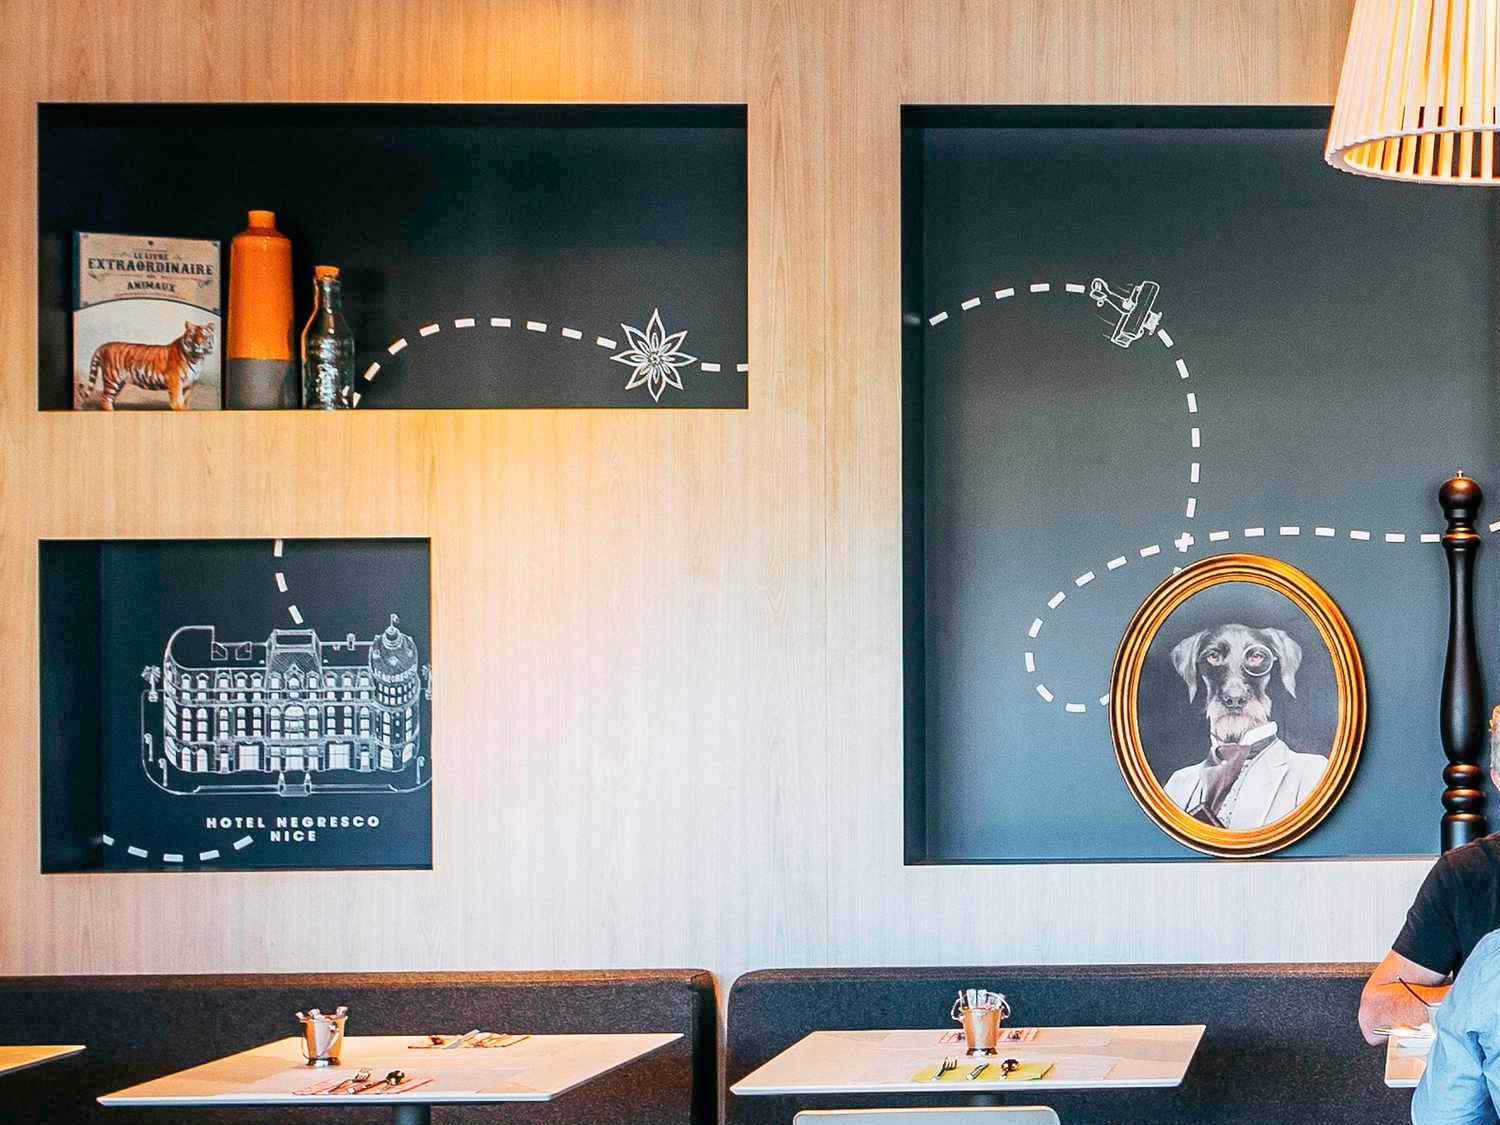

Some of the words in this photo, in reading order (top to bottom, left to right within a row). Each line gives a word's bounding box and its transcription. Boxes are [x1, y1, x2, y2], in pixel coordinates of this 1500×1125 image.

[88, 258, 214, 275] EXTRAORDINAIRE
[127, 281, 176, 292] ANIMAUX
[206, 817, 266, 829] HOTEL
[276, 816, 381, 828] NEGRESCO
[270, 830, 318, 842] NICE
